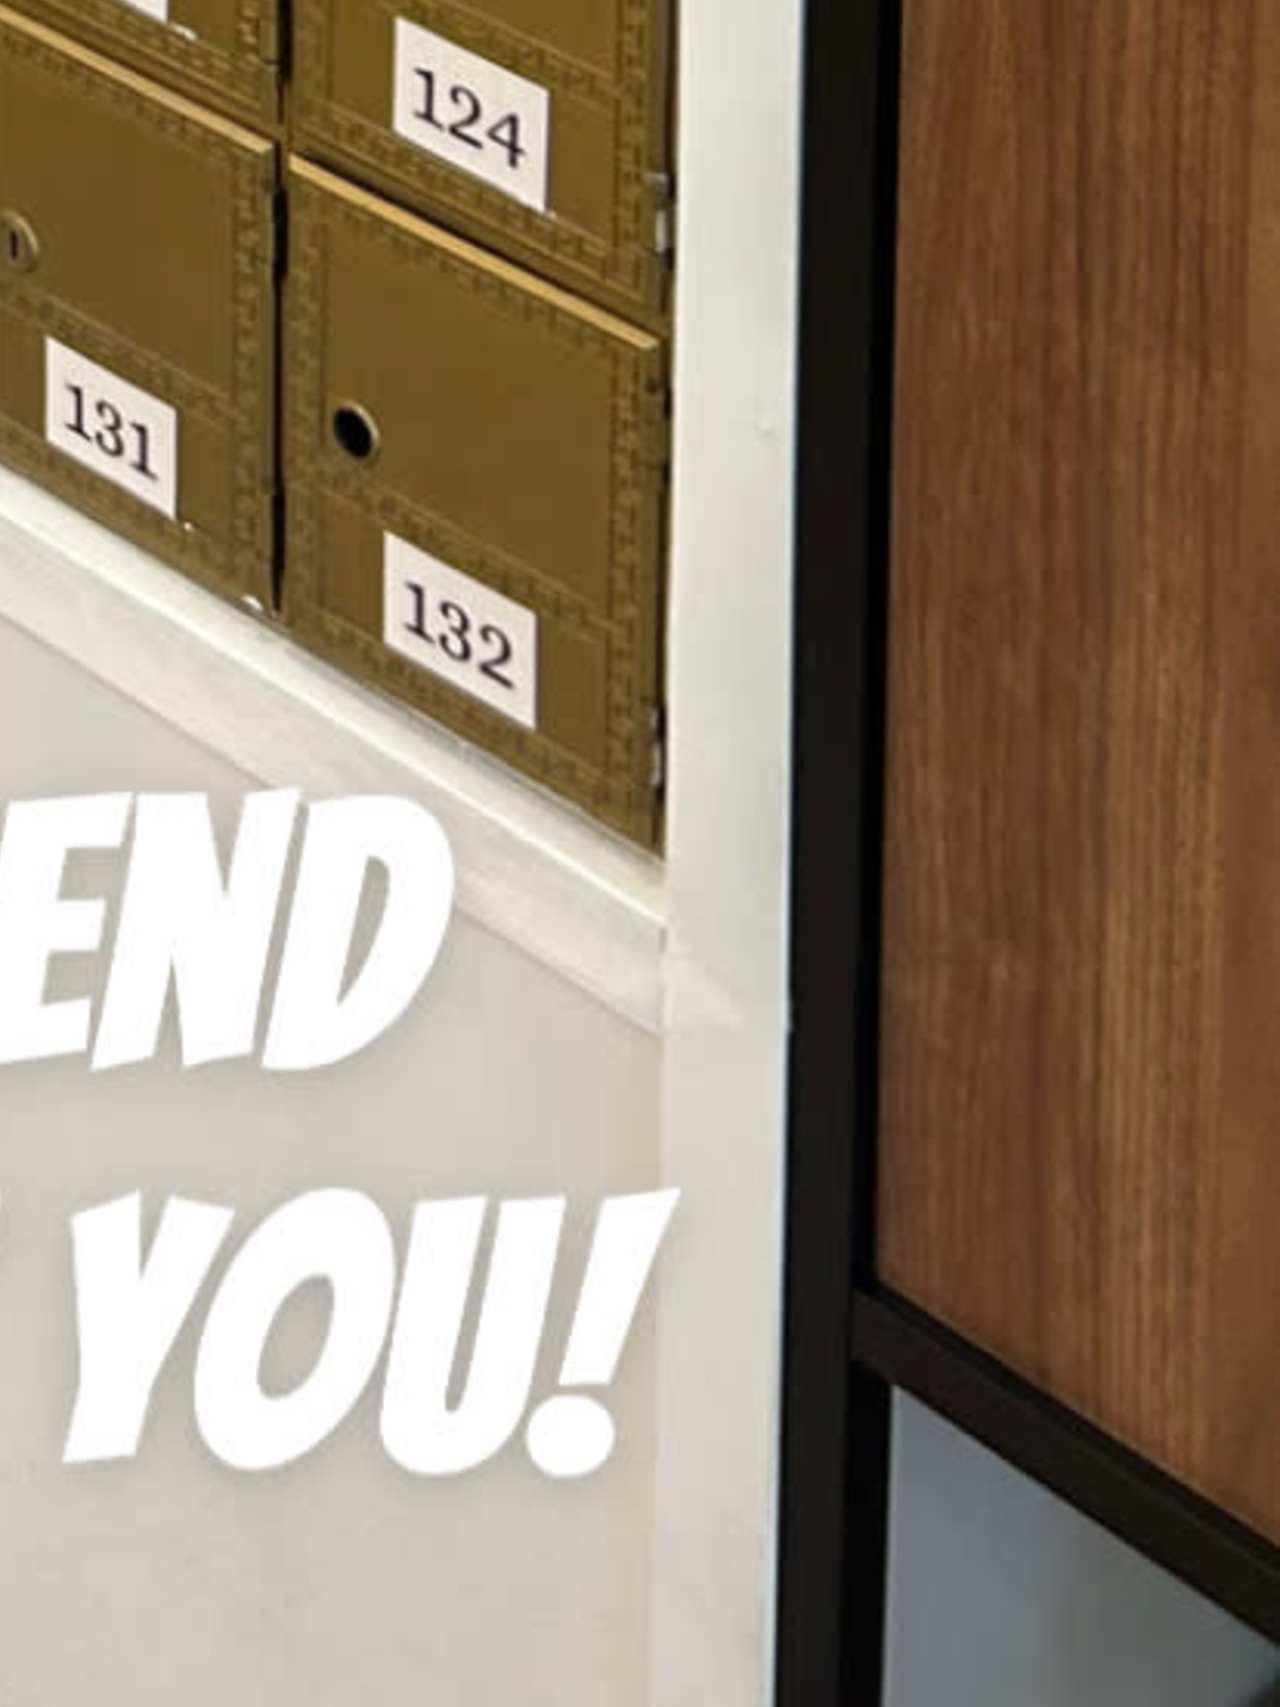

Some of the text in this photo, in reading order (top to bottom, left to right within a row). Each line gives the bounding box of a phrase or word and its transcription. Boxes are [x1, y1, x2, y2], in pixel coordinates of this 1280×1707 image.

[414, 67, 525, 169] 124
[65, 384, 158, 481] 131
[405, 582, 514, 690] 132
